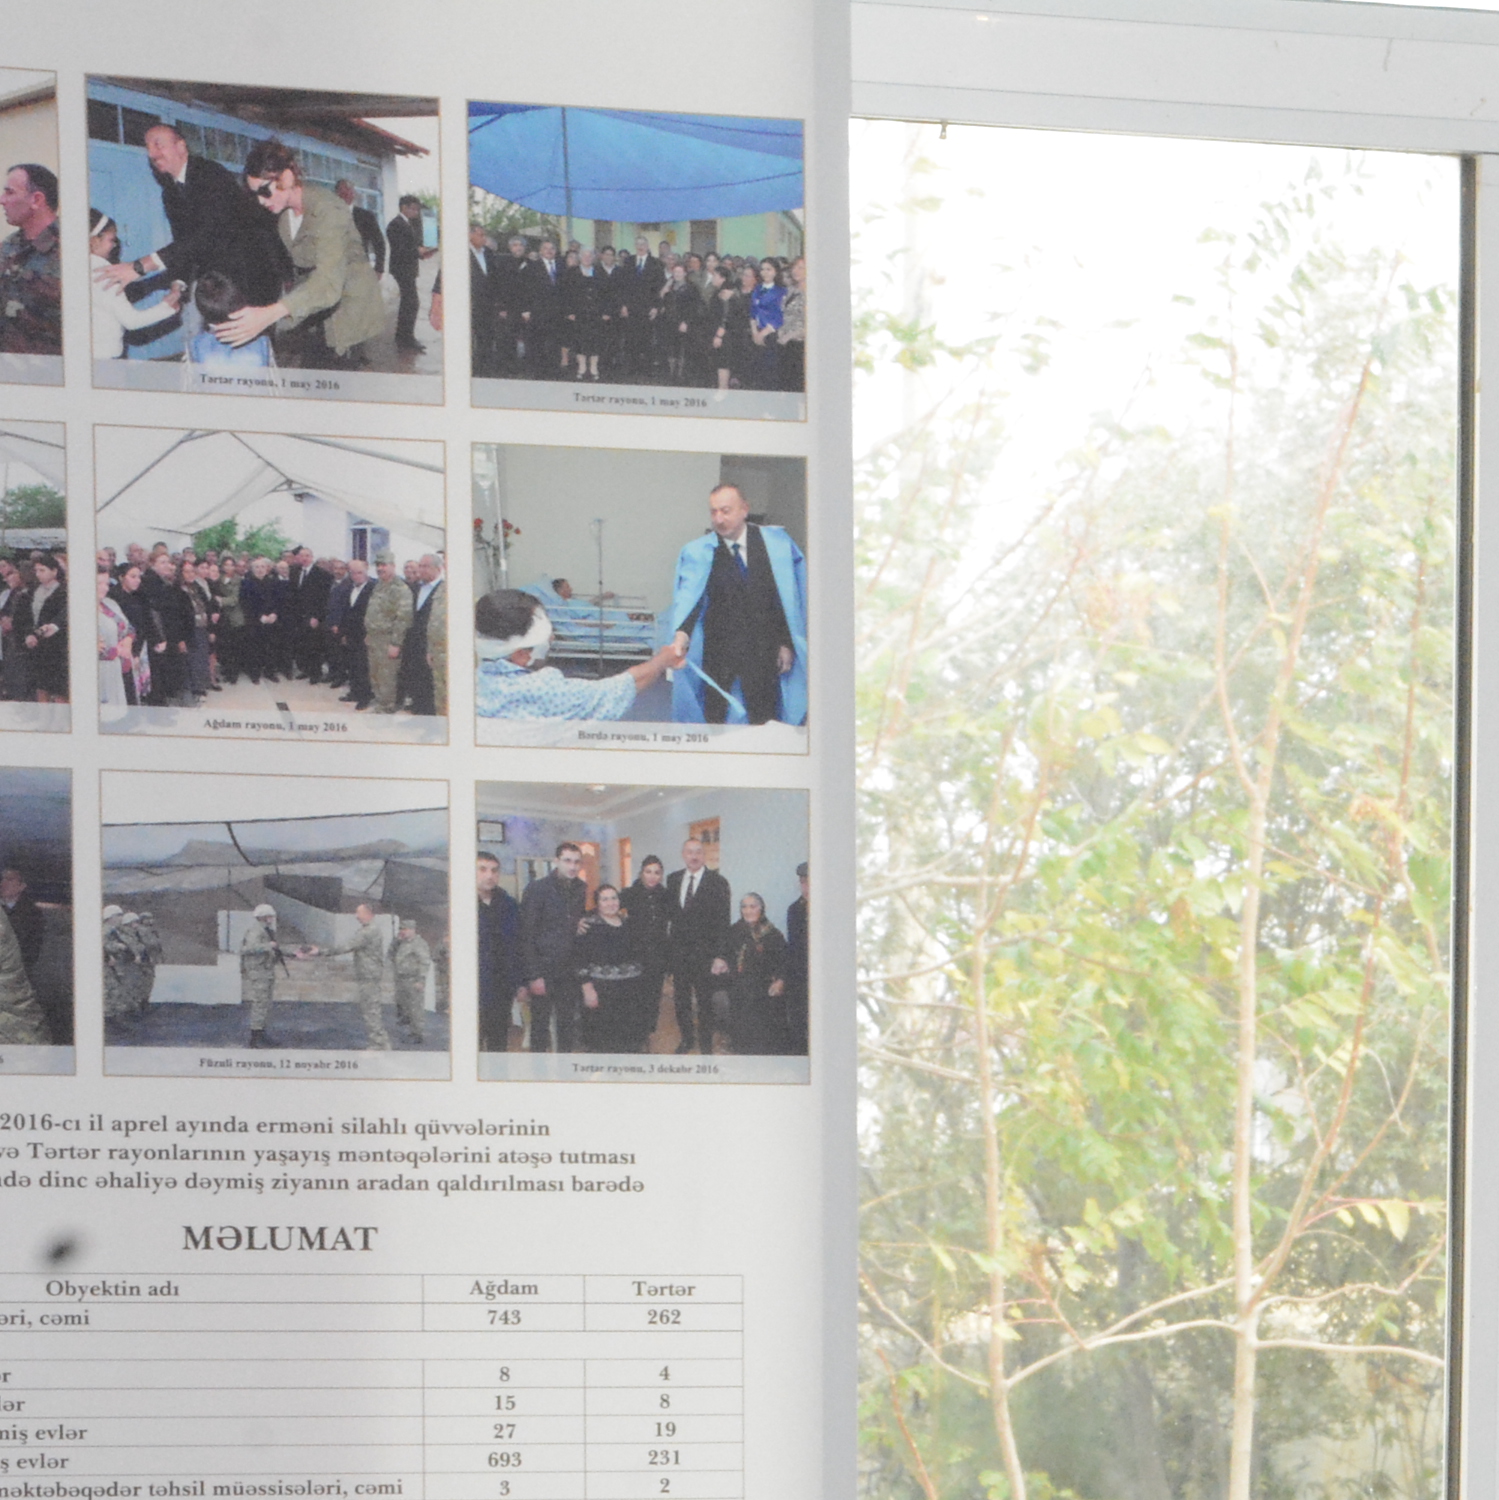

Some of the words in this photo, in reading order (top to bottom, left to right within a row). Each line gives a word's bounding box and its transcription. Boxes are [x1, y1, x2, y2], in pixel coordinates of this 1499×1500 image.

[237, 377, 278, 388] rayonu,
[281, 378, 286, 388] 1
[290, 380, 311, 391] may
[315, 379, 341, 390] 2016
[608, 396, 648, 406] rayonu,
[660, 399, 680, 409] may
[684, 398, 707, 408] 2016
[203, 718, 242, 730] Ağdam
[245, 722, 286, 732] rayonu,
[289, 721, 294, 732] 1
[298, 724, 320, 733] may
[323, 722, 348, 732] 2016
[611, 733, 650, 743] rayonu,
[653, 733, 658, 742] 1
[661, 735, 683, 745] may
[685, 734, 709, 744] 2016
[236, 1060, 277, 1070] rayonu,
[279, 1059, 292, 1069] 12
[294, 1060, 331, 1071] noyabr
[334, 1060, 359, 1069] 2016
[607, 1066, 647, 1075] rayonu,
[649, 1065, 655, 1074] 3
[657, 1065, 693, 1074] dekabr
[695, 1064, 720, 1074] 2016
[0, 1112, 81, 1132] 2016-cı
[89, 1113, 104, 1132] il
[111, 1114, 168, 1138] aprel
[175, 1115, 250, 1139] ayında
[255, 1116, 334, 1134] erməni
[340, 1116, 407, 1135] silahlı
[414, 1118, 550, 1142] qüvvələrinin
[26, 1142, 101, 1160] Tərtər
[108, 1143, 246, 1167] rayonlarının
[253, 1149, 331, 1168] yaşayış
[337, 1145, 491, 1170] məntəqələrini
[497, 1149, 553, 1169] atəşə
[559, 1150, 636, 1165] tutması
[0, 1170, 32, 1188] də
[38, 1170, 88, 1189] dinc
[94, 1170, 178, 1195] əhaliyə
[184, 1171, 265, 1195] dəymiş
[271, 1172, 350, 1196] ziyanın
[356, 1173, 430, 1191] aradan
[436, 1173, 565, 1198] qaldırılması
[571, 1174, 645, 1193] barədə
[182, 1225, 378, 1252] MƏLUMAT
[45, 1280, 142, 1301] Obyektin
[147, 1280, 180, 1297] adı
[469, 1278, 539, 1301] Ağdam
[631, 1280, 697, 1297] Tərtər
[39, 1309, 90, 1326] cəmi
[487, 1309, 522, 1326] 743
[647, 1308, 682, 1325] 262
[499, 1366, 511, 1383] 8
[658, 1365, 670, 1381] 4
[495, 1394, 517, 1411] 15
[659, 1393, 671, 1410] 8
[34, 1423, 88, 1441] evlər
[493, 1422, 517, 1440] 27
[655, 1421, 677, 1438] 19
[16, 1452, 70, 1470] evlər
[487, 1451, 523, 1468] 693
[648, 1449, 680, 1466] 231
[148, 1480, 205, 1497] təhsil
[212, 1479, 348, 1499] müəssisələri,
[354, 1478, 403, 1496] cəmi
[499, 1479, 511, 1497] 3
[659, 1477, 671, 1494] 2
